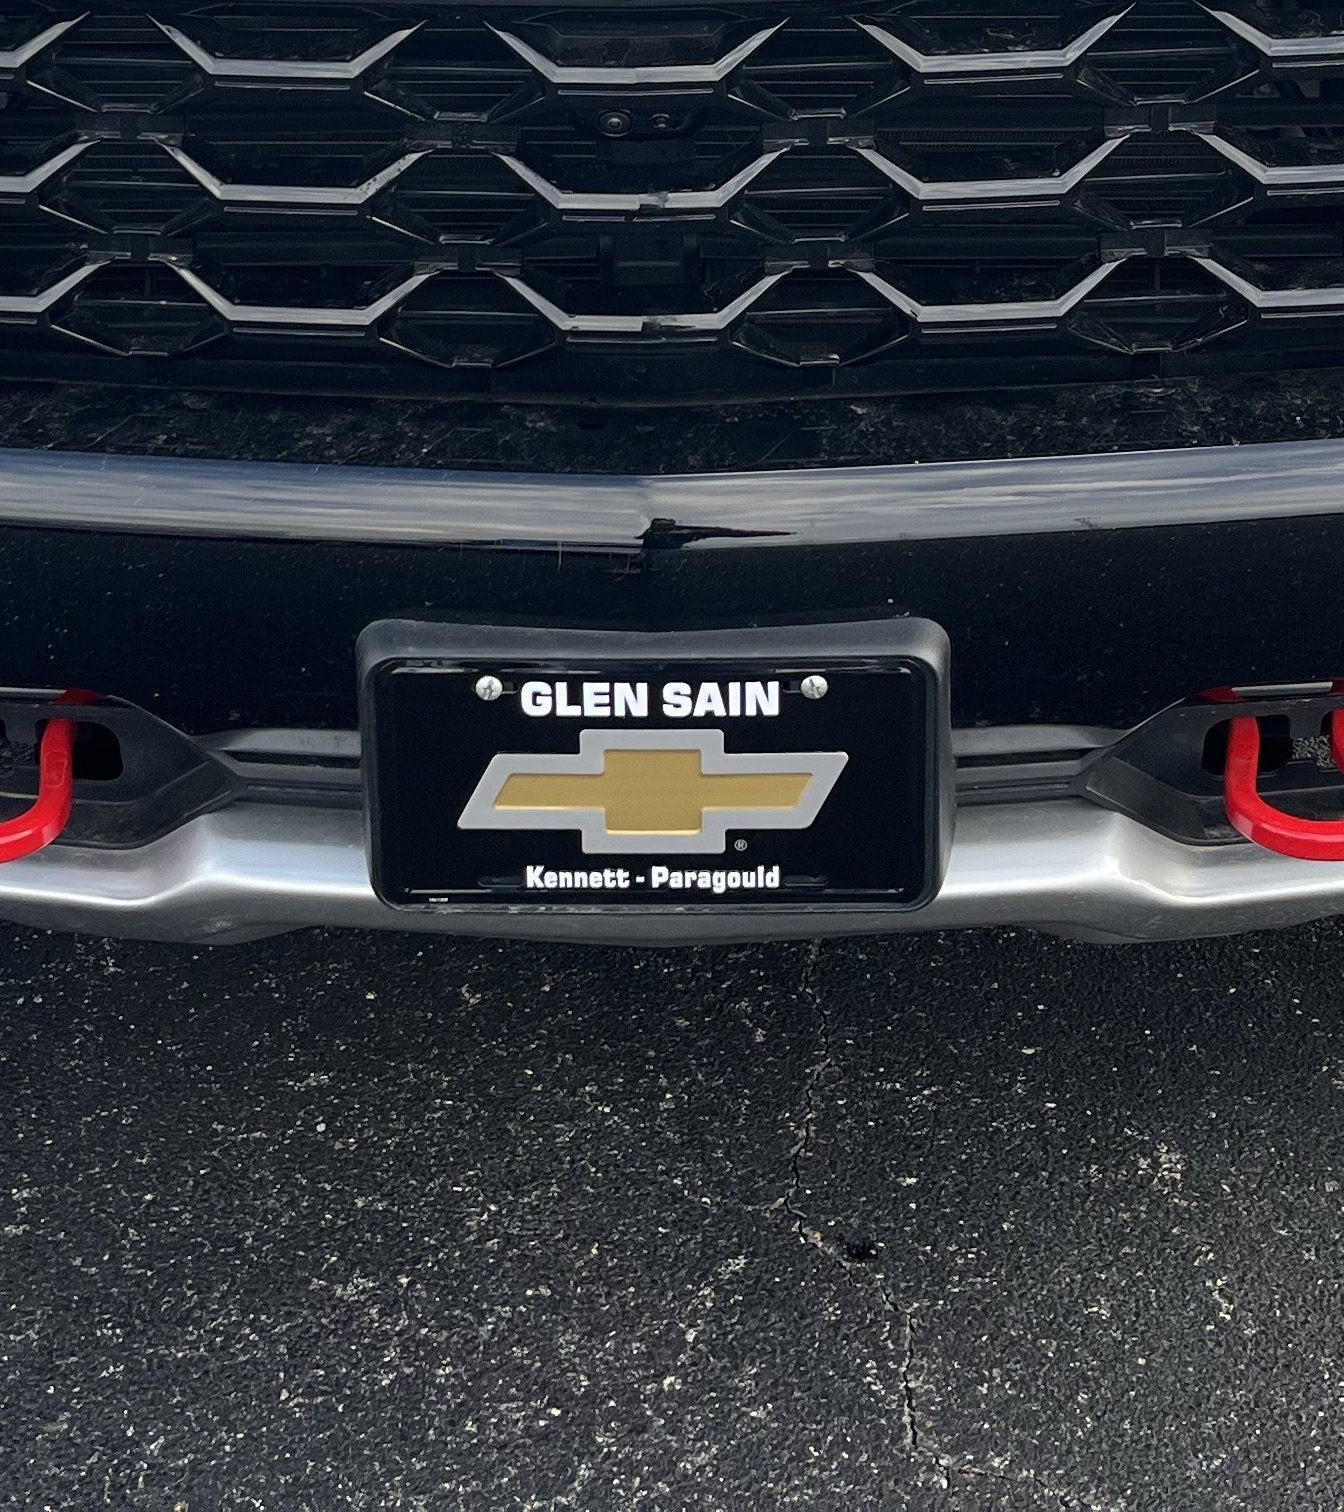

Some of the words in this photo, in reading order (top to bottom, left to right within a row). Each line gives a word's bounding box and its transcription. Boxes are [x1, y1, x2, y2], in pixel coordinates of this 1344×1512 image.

[521, 681, 649, 719] GLEN
[662, 680, 780, 718] SAIN
[526, 865, 631, 890] Kennett
[651, 865, 780, 894] Paragould
